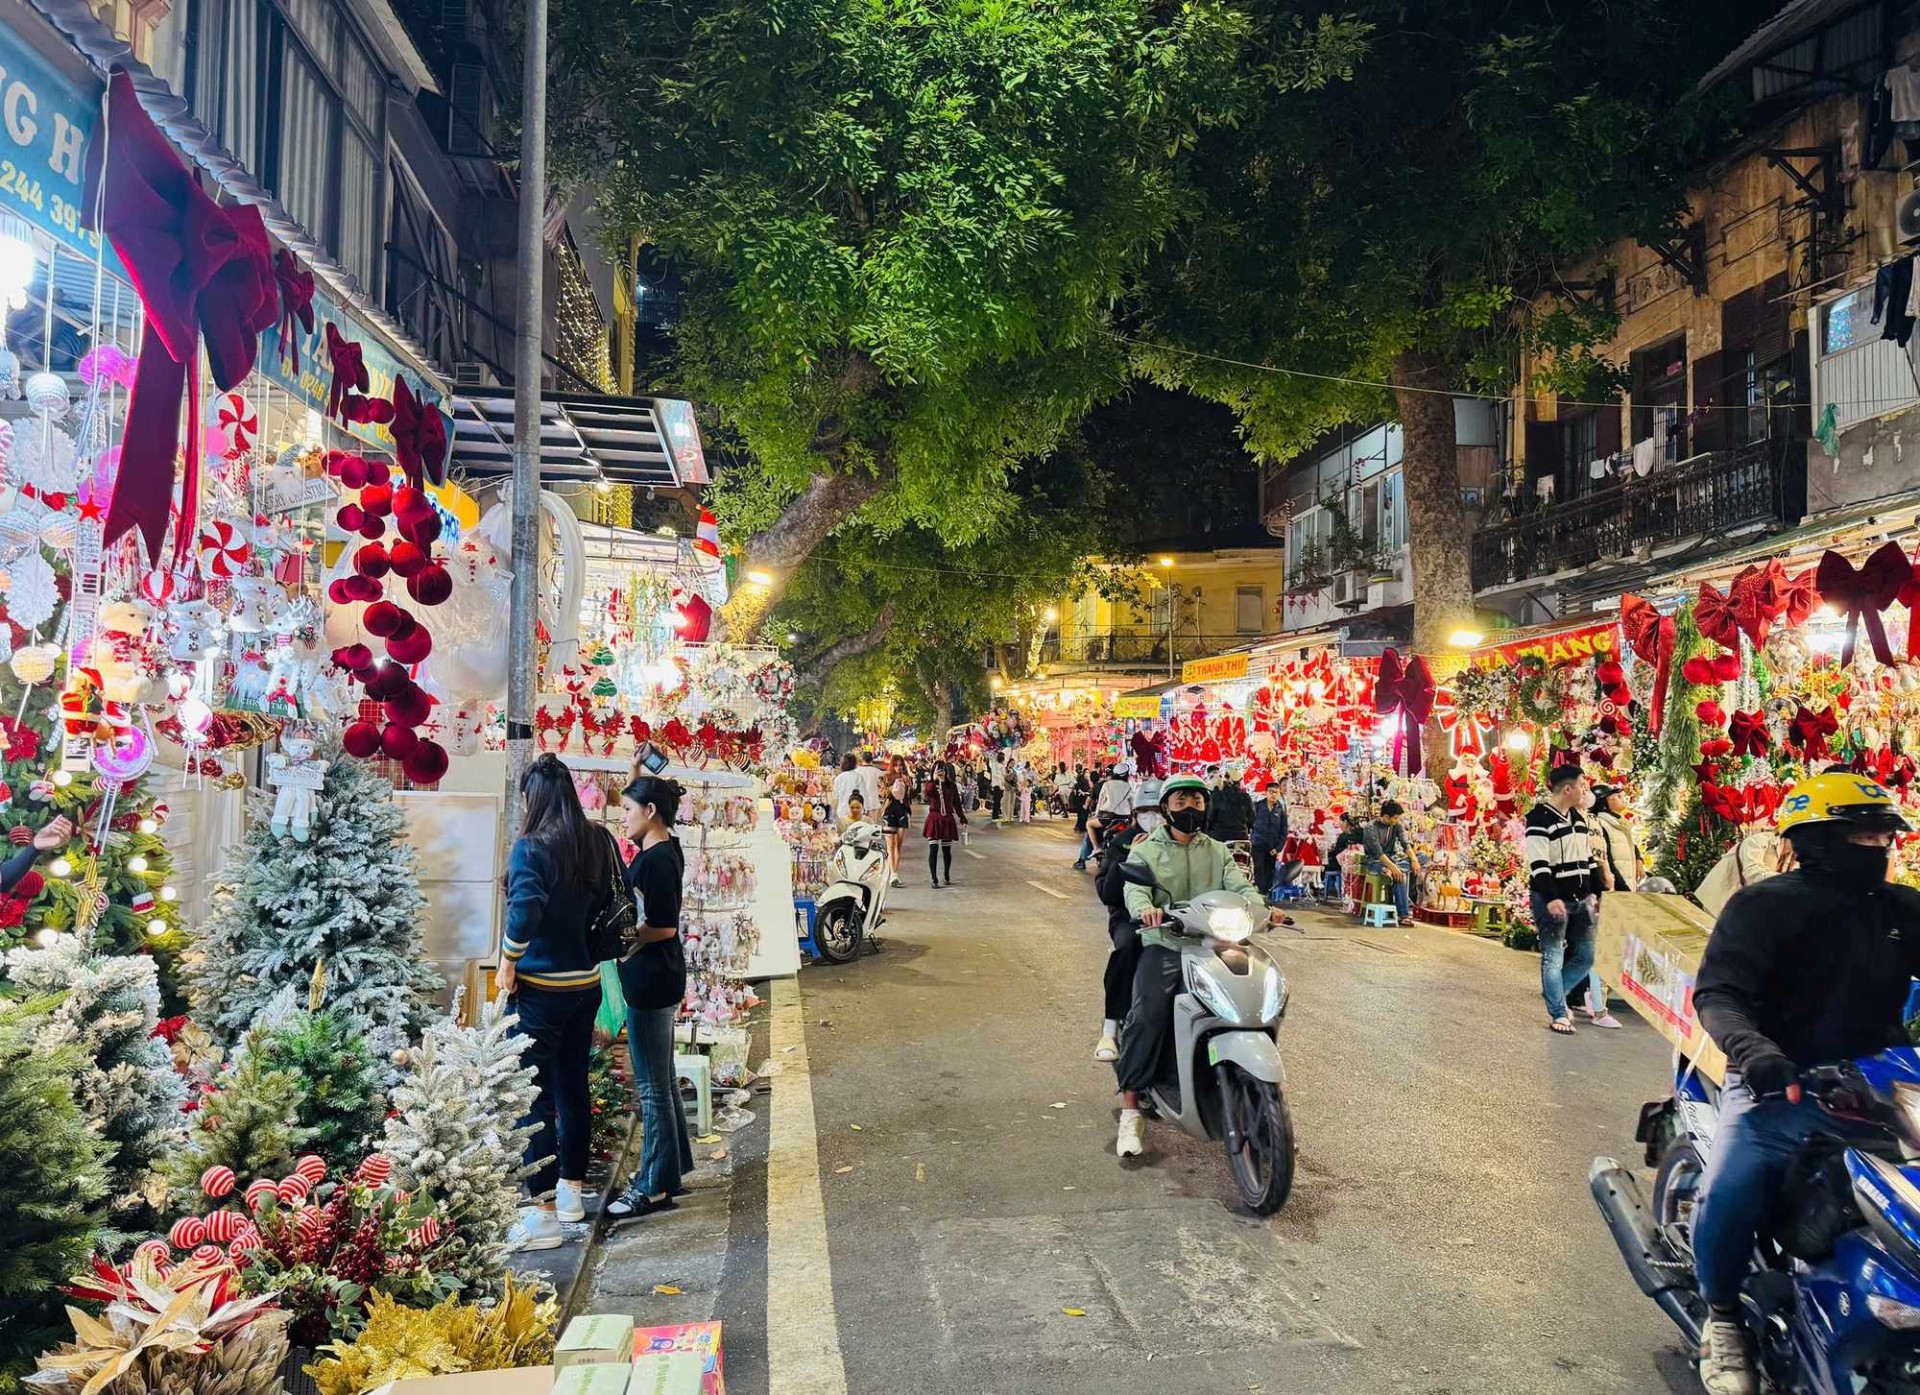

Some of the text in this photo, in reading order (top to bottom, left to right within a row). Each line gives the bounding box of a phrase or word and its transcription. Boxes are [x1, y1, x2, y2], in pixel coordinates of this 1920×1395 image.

[0, 65, 38, 147] G
[1516, 631, 1611, 664] TRANG
[1197, 662, 1223, 676] THANH
